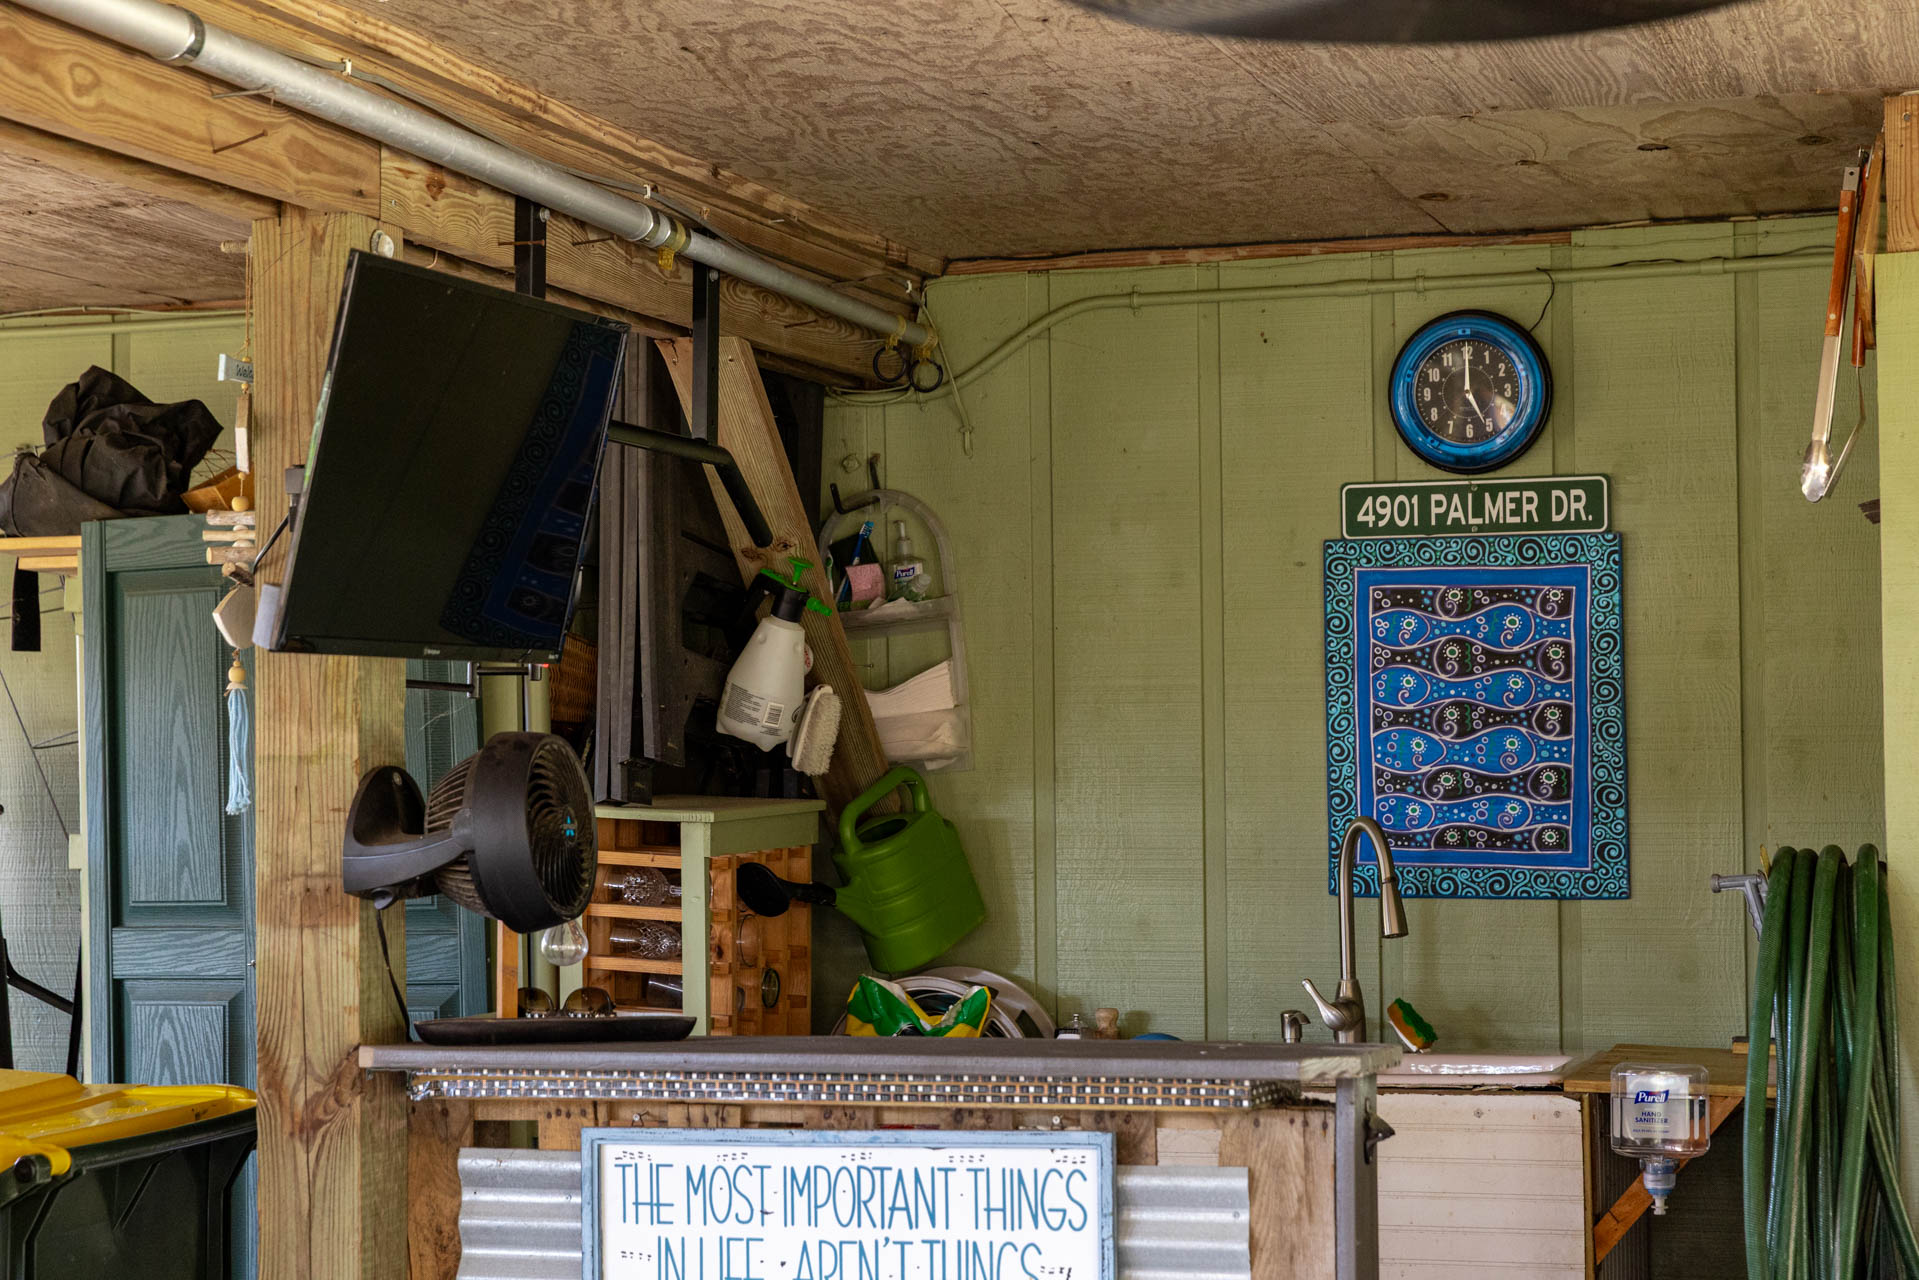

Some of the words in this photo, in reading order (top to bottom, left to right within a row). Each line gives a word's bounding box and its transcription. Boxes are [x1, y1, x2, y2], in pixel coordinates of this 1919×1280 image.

[1442, 352, 1453, 367] 11
[1461, 345, 1474, 360] 12
[1484, 350, 1490, 364] 1
[1427, 368, 1440, 382] 10
[1498, 363, 1505, 377] 2
[1423, 387, 1431, 401] 9
[1504, 383, 1512, 397] 3
[1430, 407, 1438, 421] 8
[1500, 403, 1508, 417] 4
[1447, 420, 1454, 434] 7
[1466, 424, 1474, 438] 6
[1485, 418, 1493, 432] 5
[1357, 494, 1419, 528] 4901
[1430, 490, 1539, 526] PALMER
[1551, 489, 1593, 523] DR.
[1637, 1091, 1667, 1103] Purell
[614, 1162, 675, 1226] THE
[686, 1163, 772, 1227] MOST
[783, 1164, 957, 1231] IMPORTANT
[966, 1166, 1088, 1232] THINGS
[658, 1235, 685, 1280] IN
[792, 1236, 914, 1280] AREN'T
